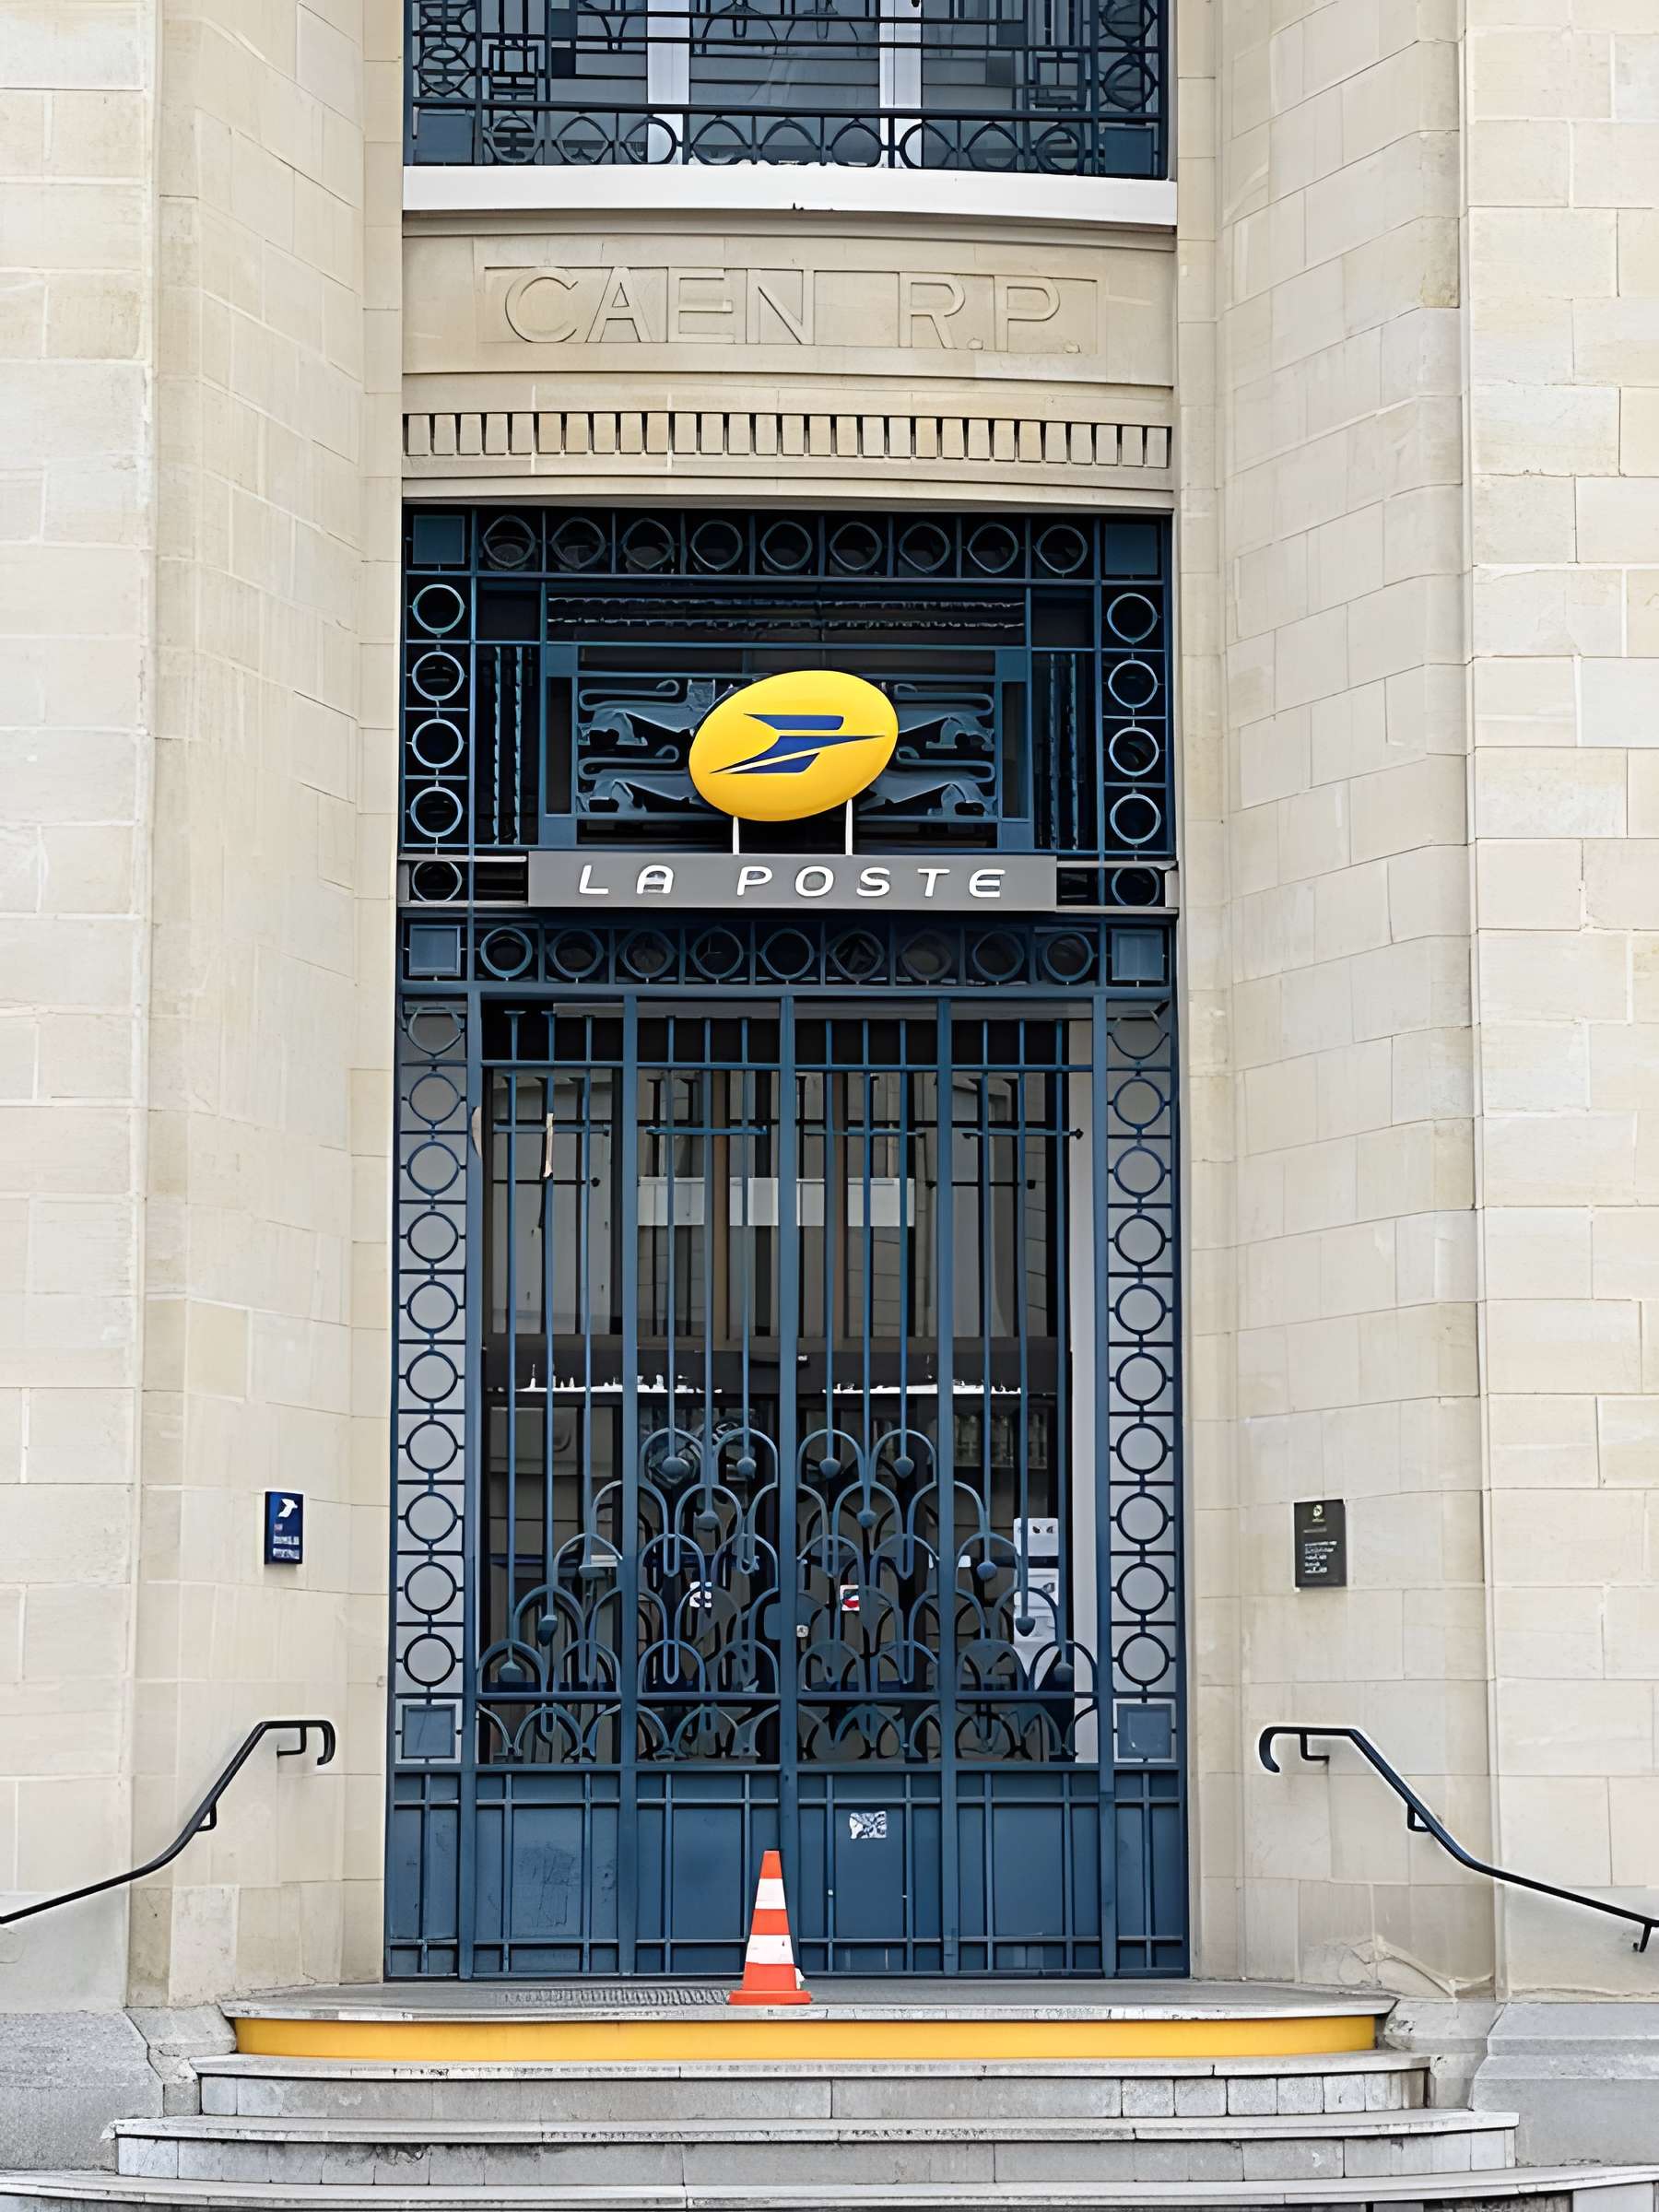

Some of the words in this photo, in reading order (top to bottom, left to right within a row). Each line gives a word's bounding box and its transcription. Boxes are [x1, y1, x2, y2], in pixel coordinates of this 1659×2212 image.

[504, 265, 815, 346] CAEN
[900, 272, 1081, 355] R.P.
[578, 865, 676, 896] LA
[736, 865, 1006, 899] POSTE
